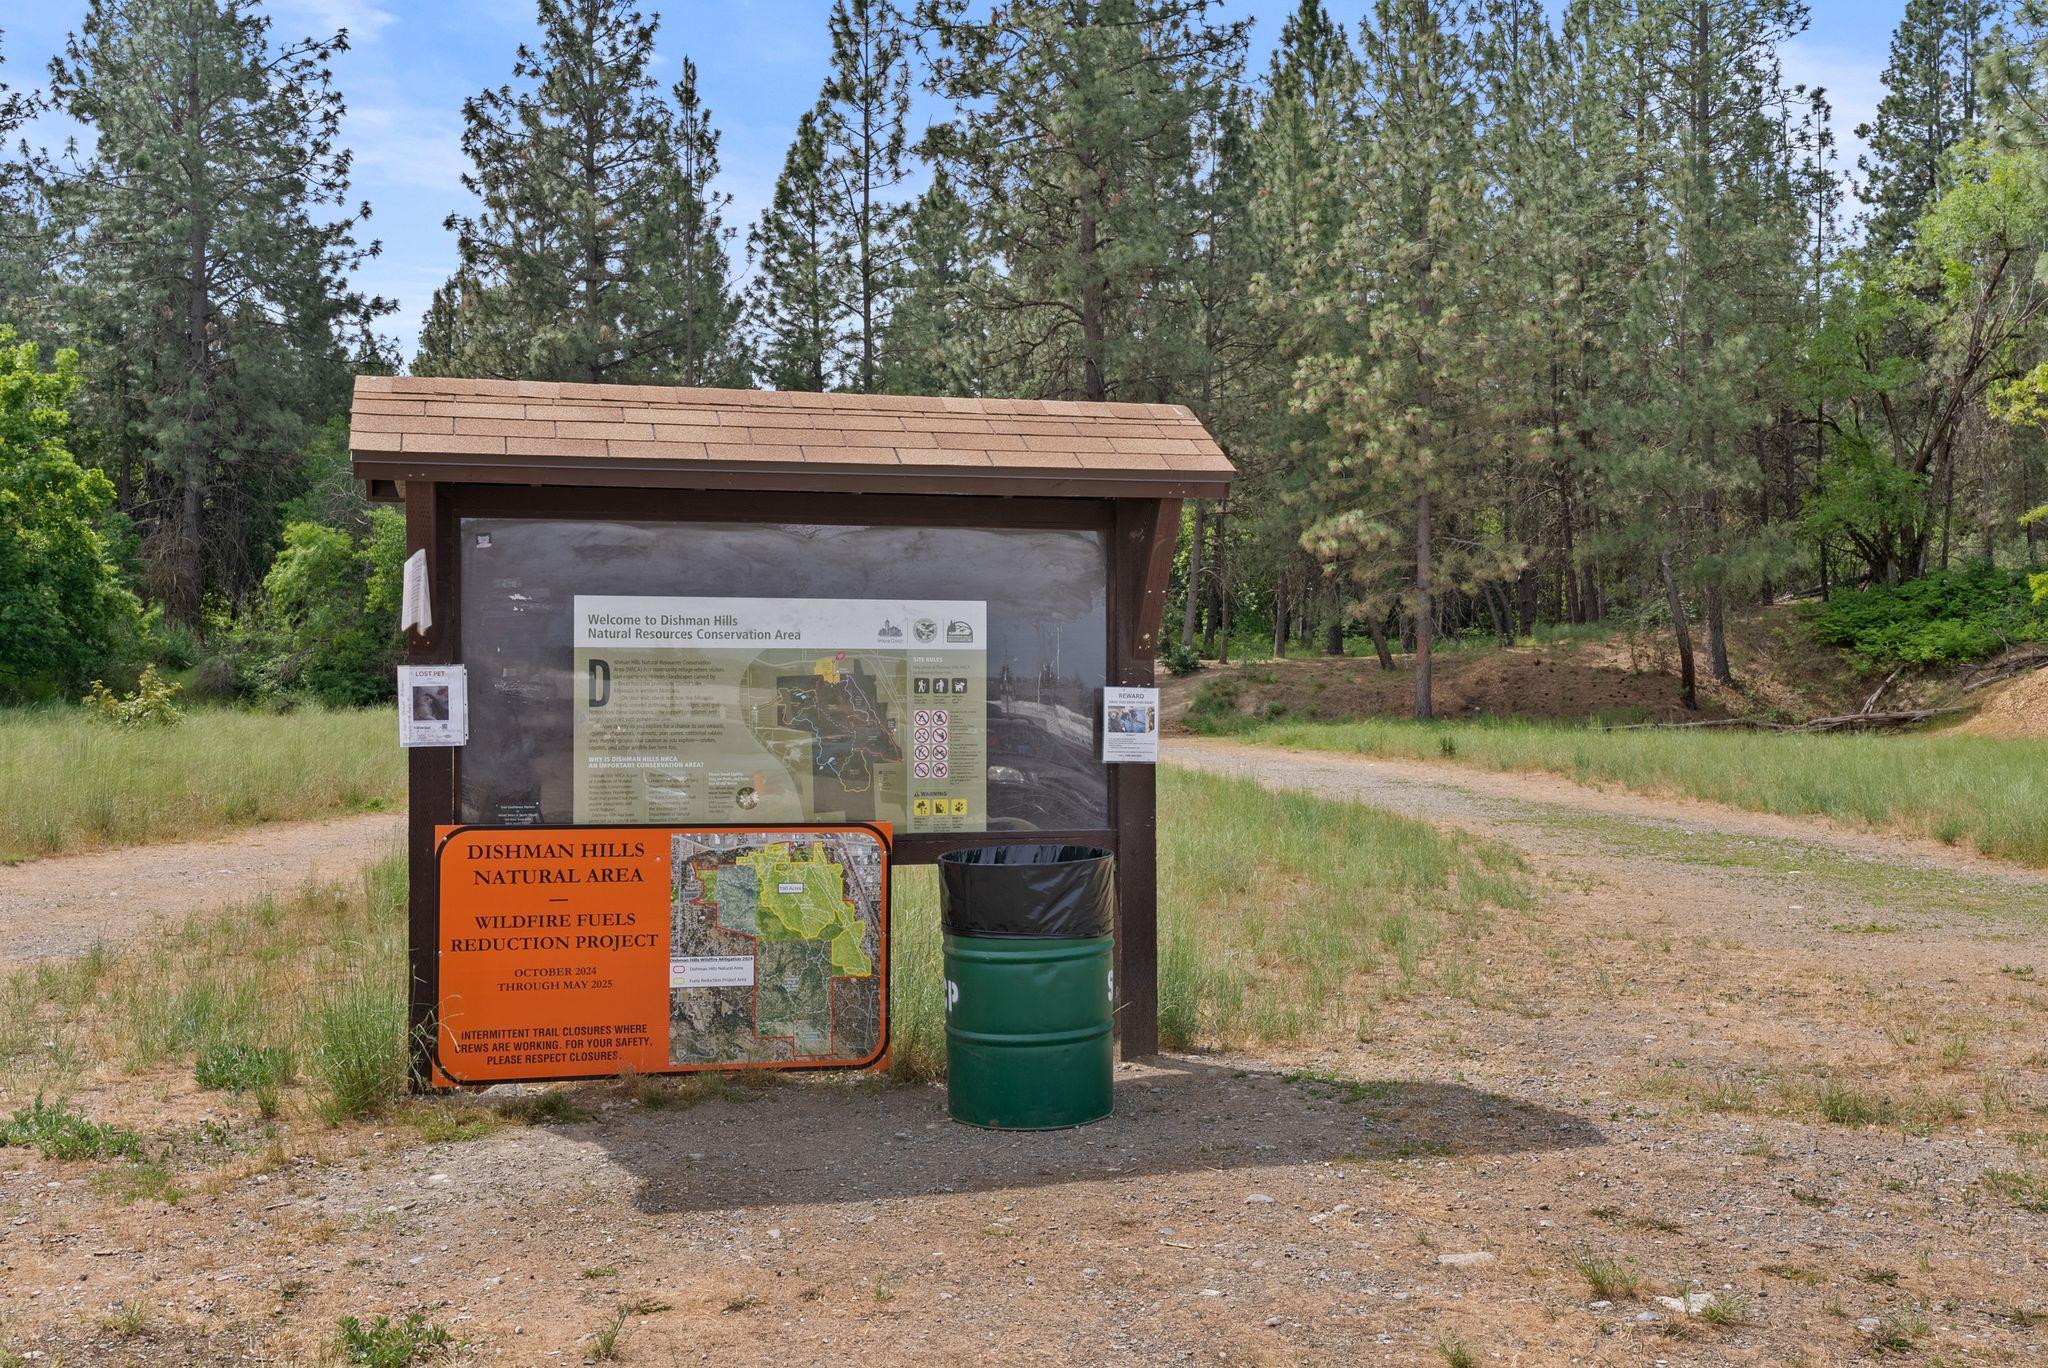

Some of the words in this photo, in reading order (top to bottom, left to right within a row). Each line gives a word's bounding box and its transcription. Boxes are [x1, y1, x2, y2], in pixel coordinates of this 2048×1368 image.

[588, 614, 641, 625] Welcome
[645, 615, 656, 625] to
[661, 615, 710, 626] Dishman
[714, 615, 738, 626] Hills
[588, 628, 631, 639] Natural
[635, 629, 693, 640] Resources
[697, 629, 771, 640] Conservation
[775, 630, 801, 640] Area
[467, 844, 574, 860] DISHMAN
[581, 843, 645, 859] HILLS
[473, 868, 581, 885] NATURAL
[586, 867, 644, 883] AREA
[475, 914, 571, 930] WILDFIRE
[577, 912, 636, 927] FUELS
[451, 936, 570, 952] REDUCTION
[575, 933, 659, 952] PROJECT
[514, 967, 572, 978] OCTOBER
[575, 967, 597, 977] 2024
[497, 982, 560, 992] THROUGH
[563, 981, 589, 990] MAY
[591, 980, 613, 989] 2025
[461, 1028, 531, 1040] INTERMITTENT
[533, 1027, 559, 1038] TRAIL
[562, 1025, 612, 1037] CLOSURES
[614, 1024, 647, 1035] WHERE
[454, 1043, 489, 1054] CREWS
[491, 1042, 511, 1052] ARE
[513, 1039, 562, 1052] WORKING.
[565, 1039, 584, 1049] FOR
[586, 1037, 613, 1049] YOUR
[615, 1037, 653, 1048] SAFETY,
[487, 1054, 523, 1066] PLEASE
[525, 1053, 566, 1064] RESPECT
[569, 1051, 622, 1063] CLOSURES.
